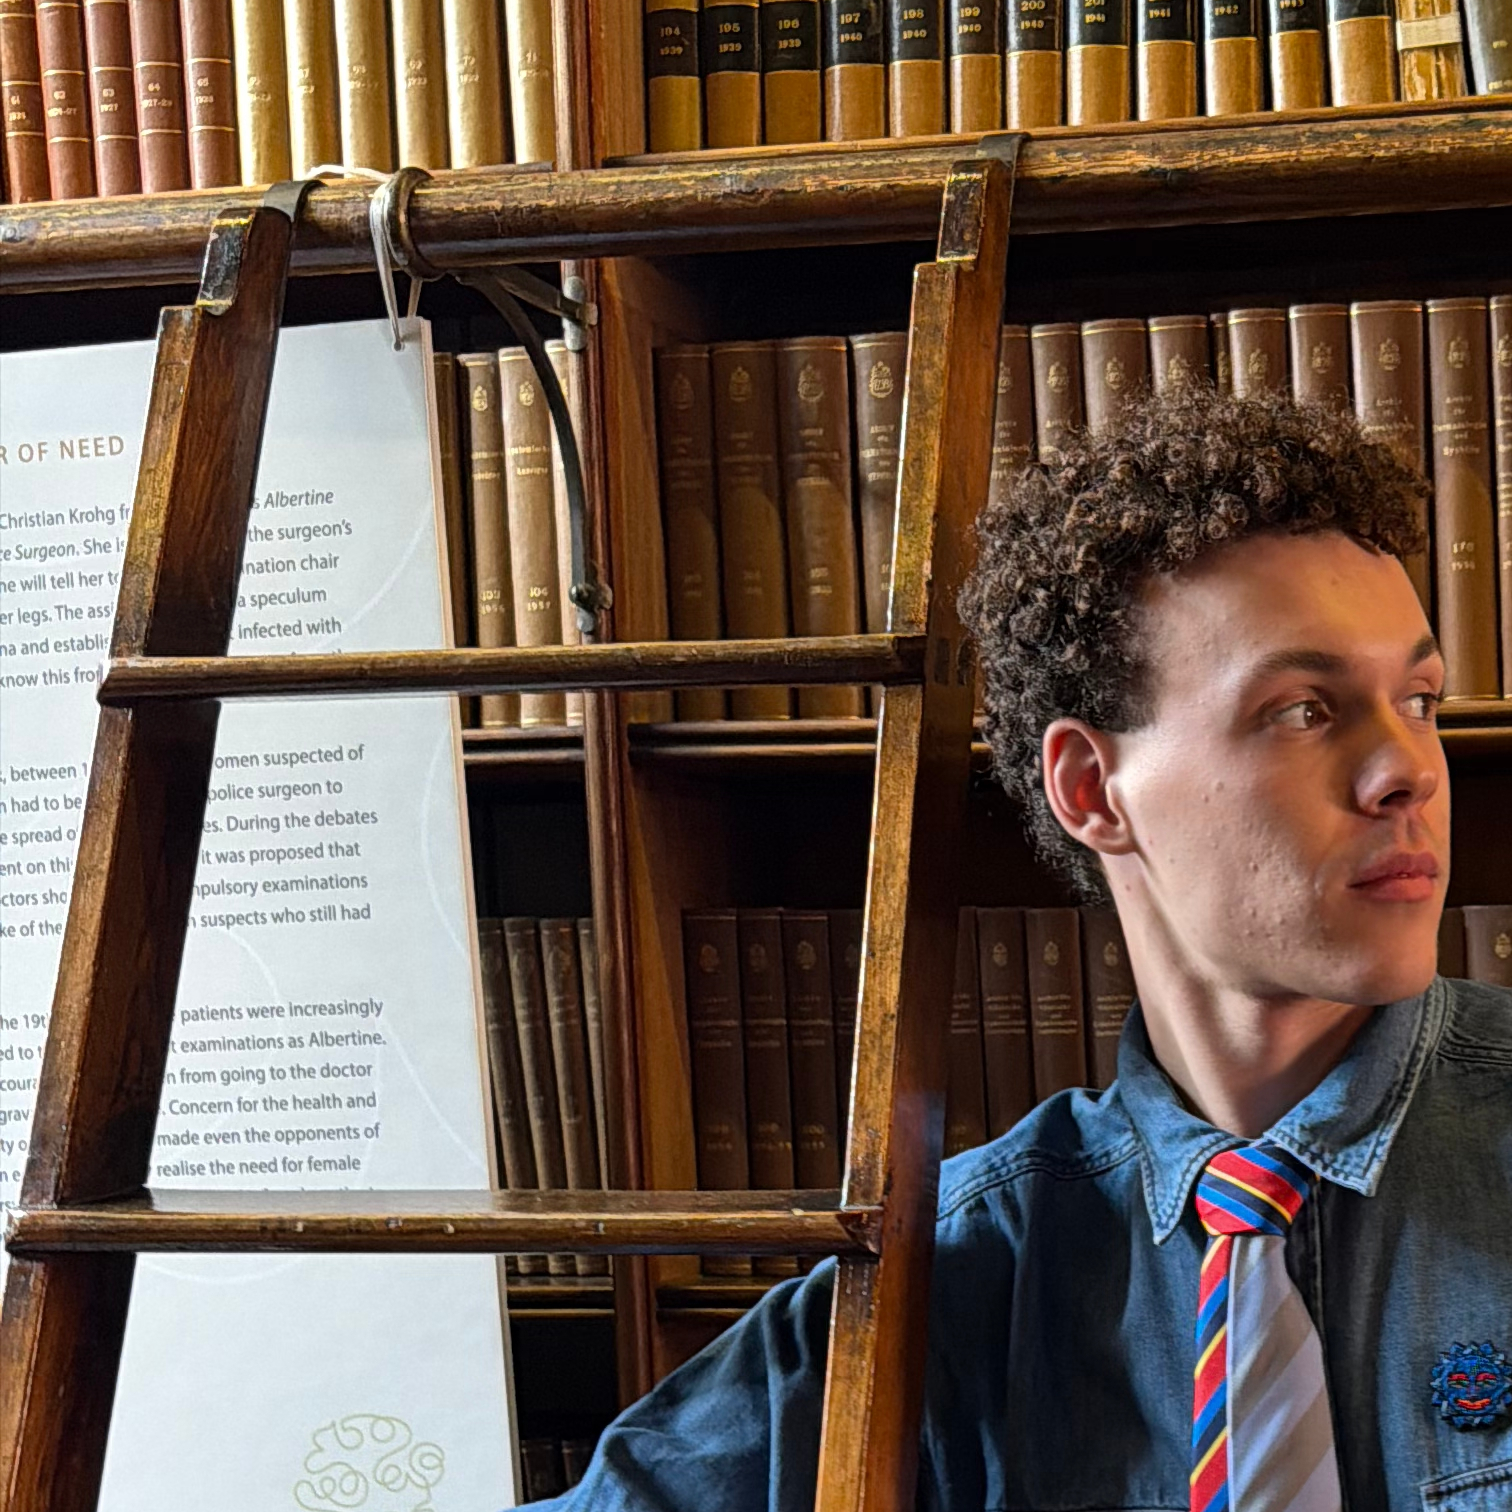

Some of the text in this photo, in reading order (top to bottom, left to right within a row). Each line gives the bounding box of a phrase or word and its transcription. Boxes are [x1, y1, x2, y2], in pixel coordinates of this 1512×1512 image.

[18, 442, 48, 463] OF
[59, 435, 124, 460] NEED
[69, 505, 115, 525] Krohg
[264, 489, 334, 509] Albertine
[15, 543, 80, 564] Surgeon.
[83, 538, 112, 555] She
[248, 525, 274, 542] the
[278, 519, 353, 542] surgeon's
[20, 574, 46, 591] will
[50, 571, 74, 589] tell
[79, 571, 104, 588] her
[300, 552, 340, 571] chair
[18, 608, 52, 627] legs.
[54, 604, 84, 621] The
[238, 595, 247, 608] a
[250, 587, 327, 610] speculum
[21, 637, 49, 655] and
[238, 620, 303, 640] infected
[306, 616, 342, 635] with
[42, 668, 70, 685] this
[10, 764, 77, 782] between
[263, 745, 344, 768] suspected
[347, 744, 365, 761] of
[11, 795, 39, 813] had
[43, 796, 60, 811] to
[64, 794, 82, 810] be
[258, 782, 322, 801] surgeon
[326, 780, 343, 794] to
[12, 825, 63, 847] spread
[226, 814, 281, 833] During
[284, 811, 311, 829] the
[314, 808, 378, 827] debates
[26, 861, 47, 874] on
[201, 849, 212, 864] it
[215, 850, 245, 864] was
[249, 842, 324, 866] proposed
[328, 841, 361, 858] that
[262, 873, 368, 893] examinations
[20, 918, 35, 936] of
[38, 918, 62, 935] the
[200, 909, 268, 930] suspects
[271, 906, 305, 923] who
[309, 904, 337, 921] still
[340, 902, 371, 920] had
[180, 1004, 244, 1026] patients
[247, 1004, 285, 1019] were
[289, 997, 384, 1018] increasingly
[18, 1045, 34, 1061] to
[180, 1034, 285, 1053] examinations
[288, 1034, 305, 1048] as
[308, 1029, 388, 1048] Albertine.
[180, 1067, 217, 1085] from
[220, 1065, 266, 1087] going
[269, 1065, 286, 1081] to
[290, 1063, 317, 1079] the
[320, 1061, 373, 1078] doctor
[168, 1098, 234, 1116] Concern
[237, 1096, 259, 1113] for
[262, 1094, 290, 1110] the
[292, 1091, 343, 1110] health
[346, 1091, 377, 1109] and
[157, 1129, 200, 1147] made
[203, 1130, 241, 1145] even
[244, 1127, 271, 1144] the
[274, 1124, 361, 1146] opponents
[363, 1122, 381, 1139] of
[156, 1154, 362, 1178] realise the need for female
